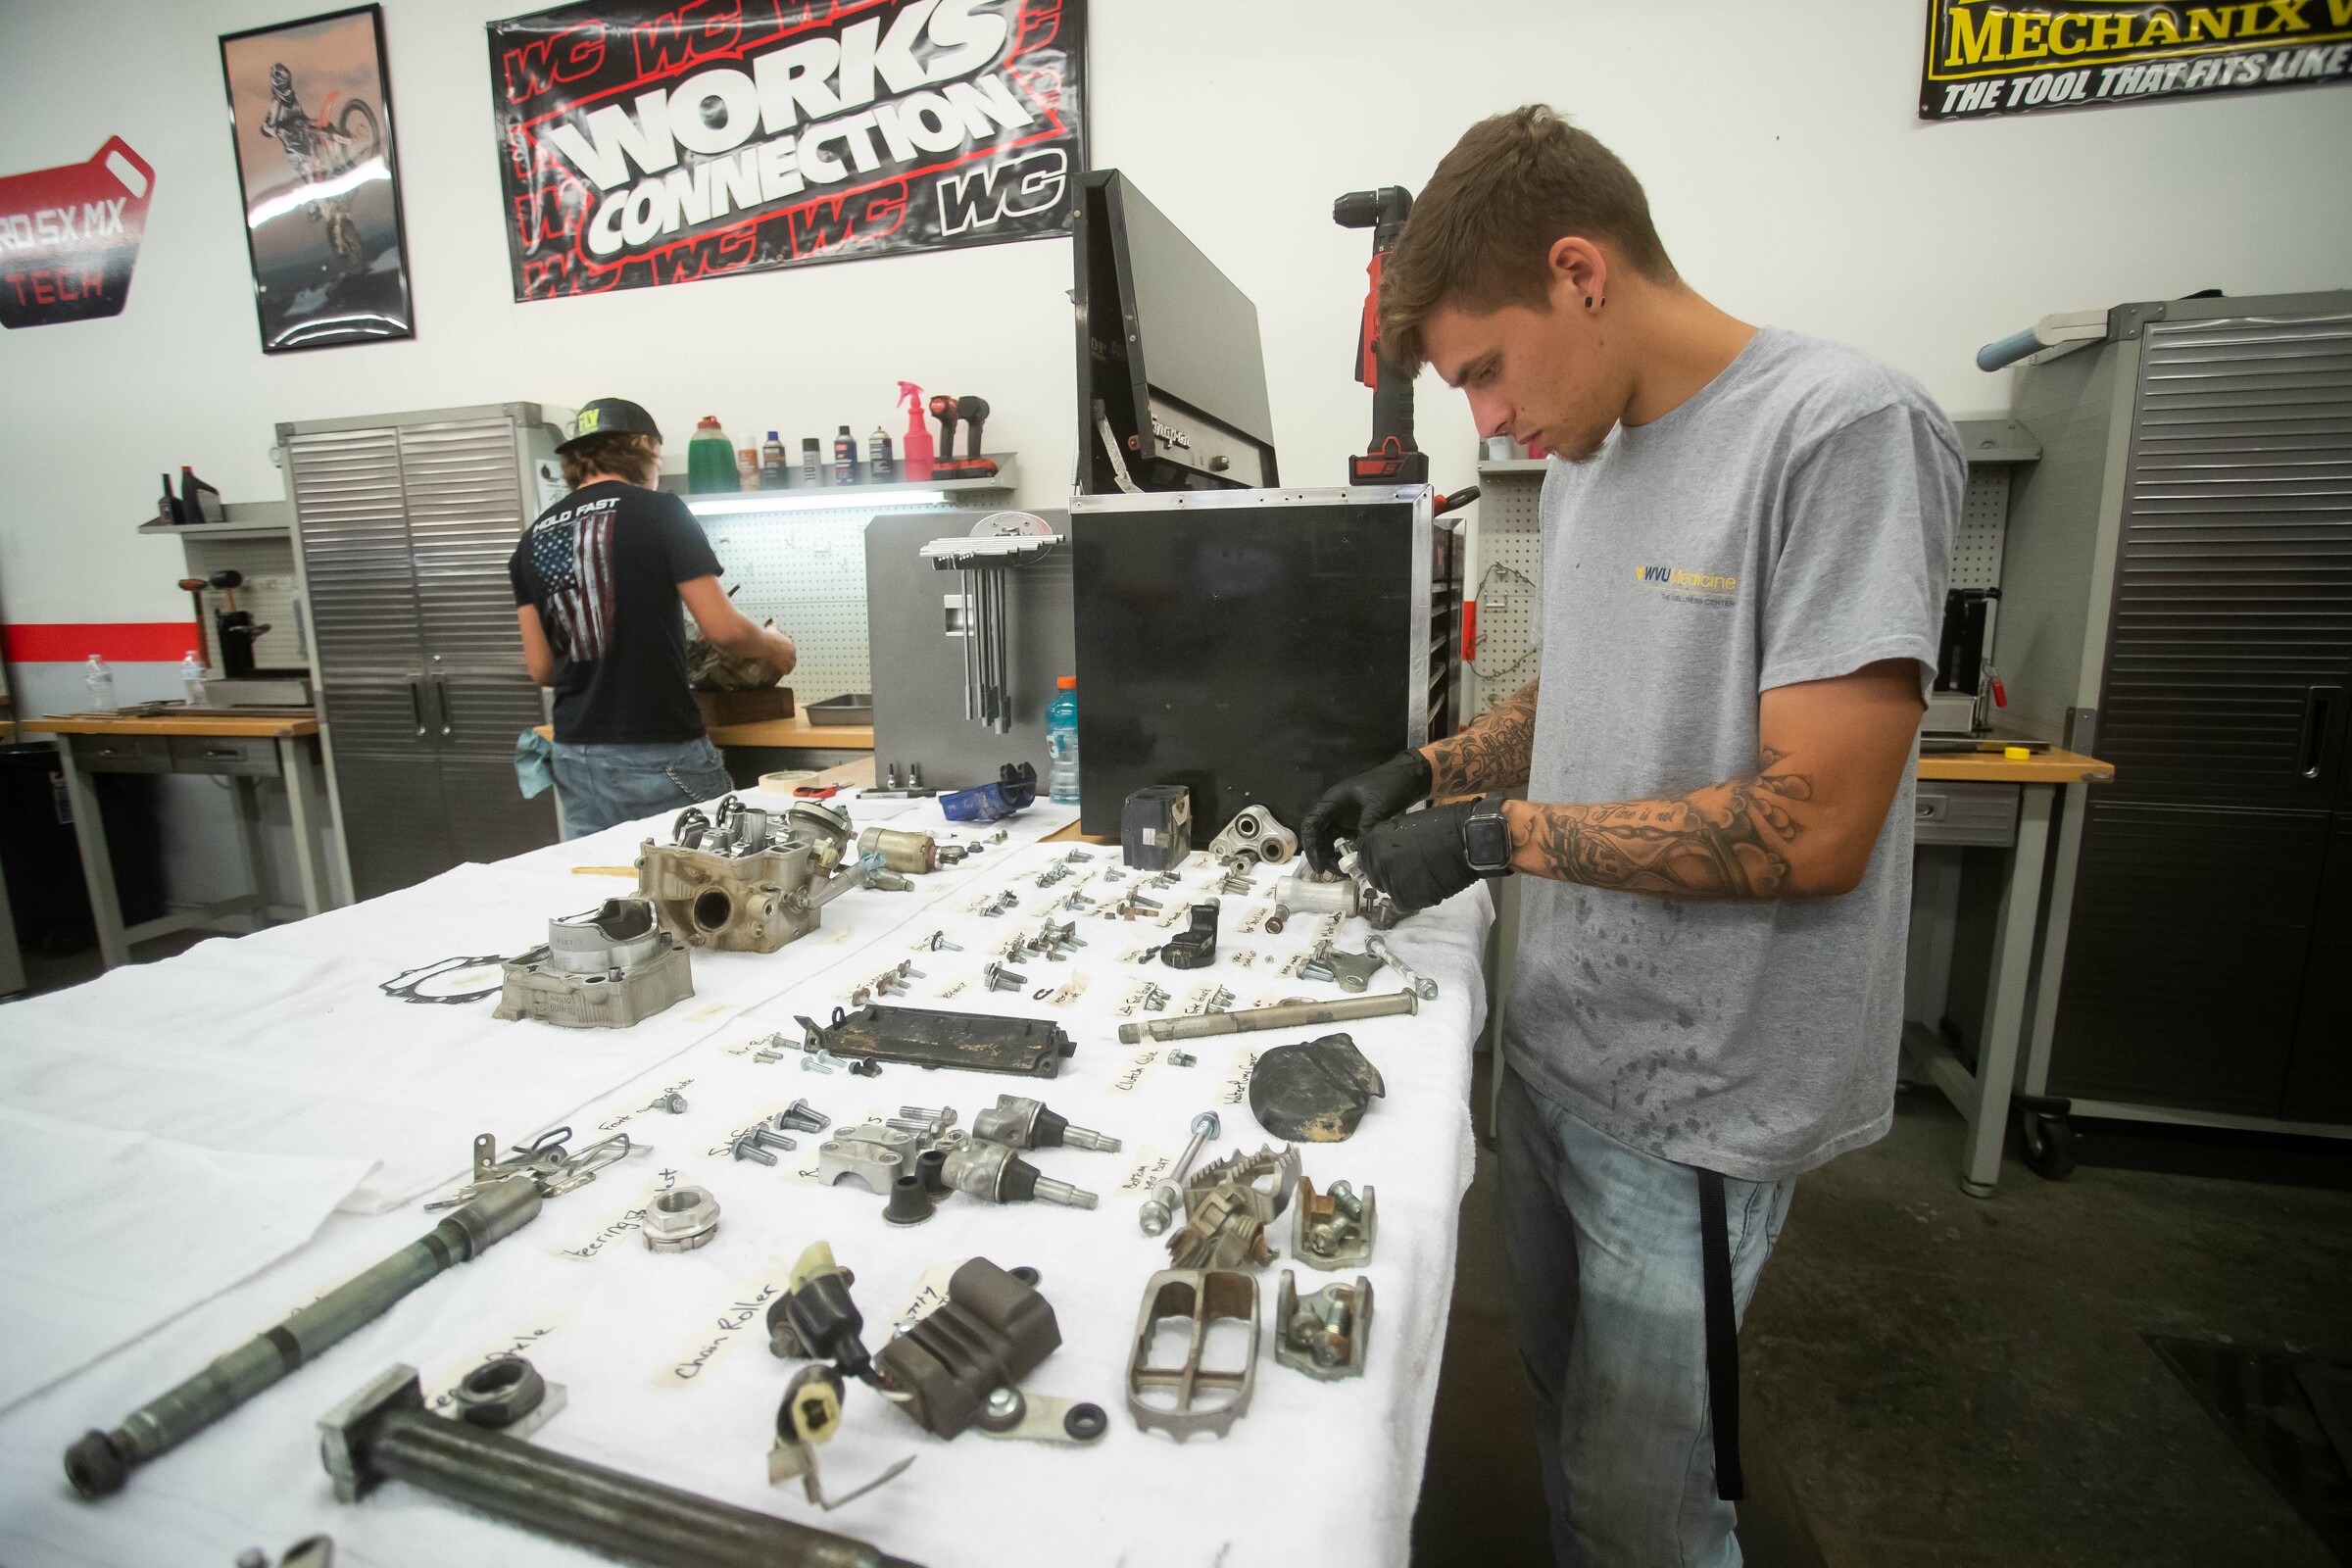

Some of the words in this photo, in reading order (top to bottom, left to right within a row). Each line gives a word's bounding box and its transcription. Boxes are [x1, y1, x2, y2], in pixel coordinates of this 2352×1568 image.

[1943, 0, 2311, 67] MECHANIX
[549, 0, 1007, 191] WORKS
[1940, 79, 2001, 114] THE
[2006, 71, 2089, 109] TOOL
[2096, 61, 2187, 99] THAT
[2184, 53, 2268, 89] FITS
[2266, 44, 2352, 81] LIKE
[589, 74, 1035, 256] CONNECTION
[937, 148, 1067, 236] WC
[35, 205, 79, 246] SX
[83, 196, 126, 239] MX
[5, 266, 103, 308] TECH
[575, 497, 622, 517] FAST
[1643, 565, 1671, 582] WVU
[1670, 567, 1737, 589] Medicine
[1671, 595, 1703, 605] WELLNESS
[1704, 598, 1736, 608] CENTER
[561, 1221, 642, 1257] teering
[674, 1336, 729, 1380] Chain
[717, 1283, 780, 1331] Roller
